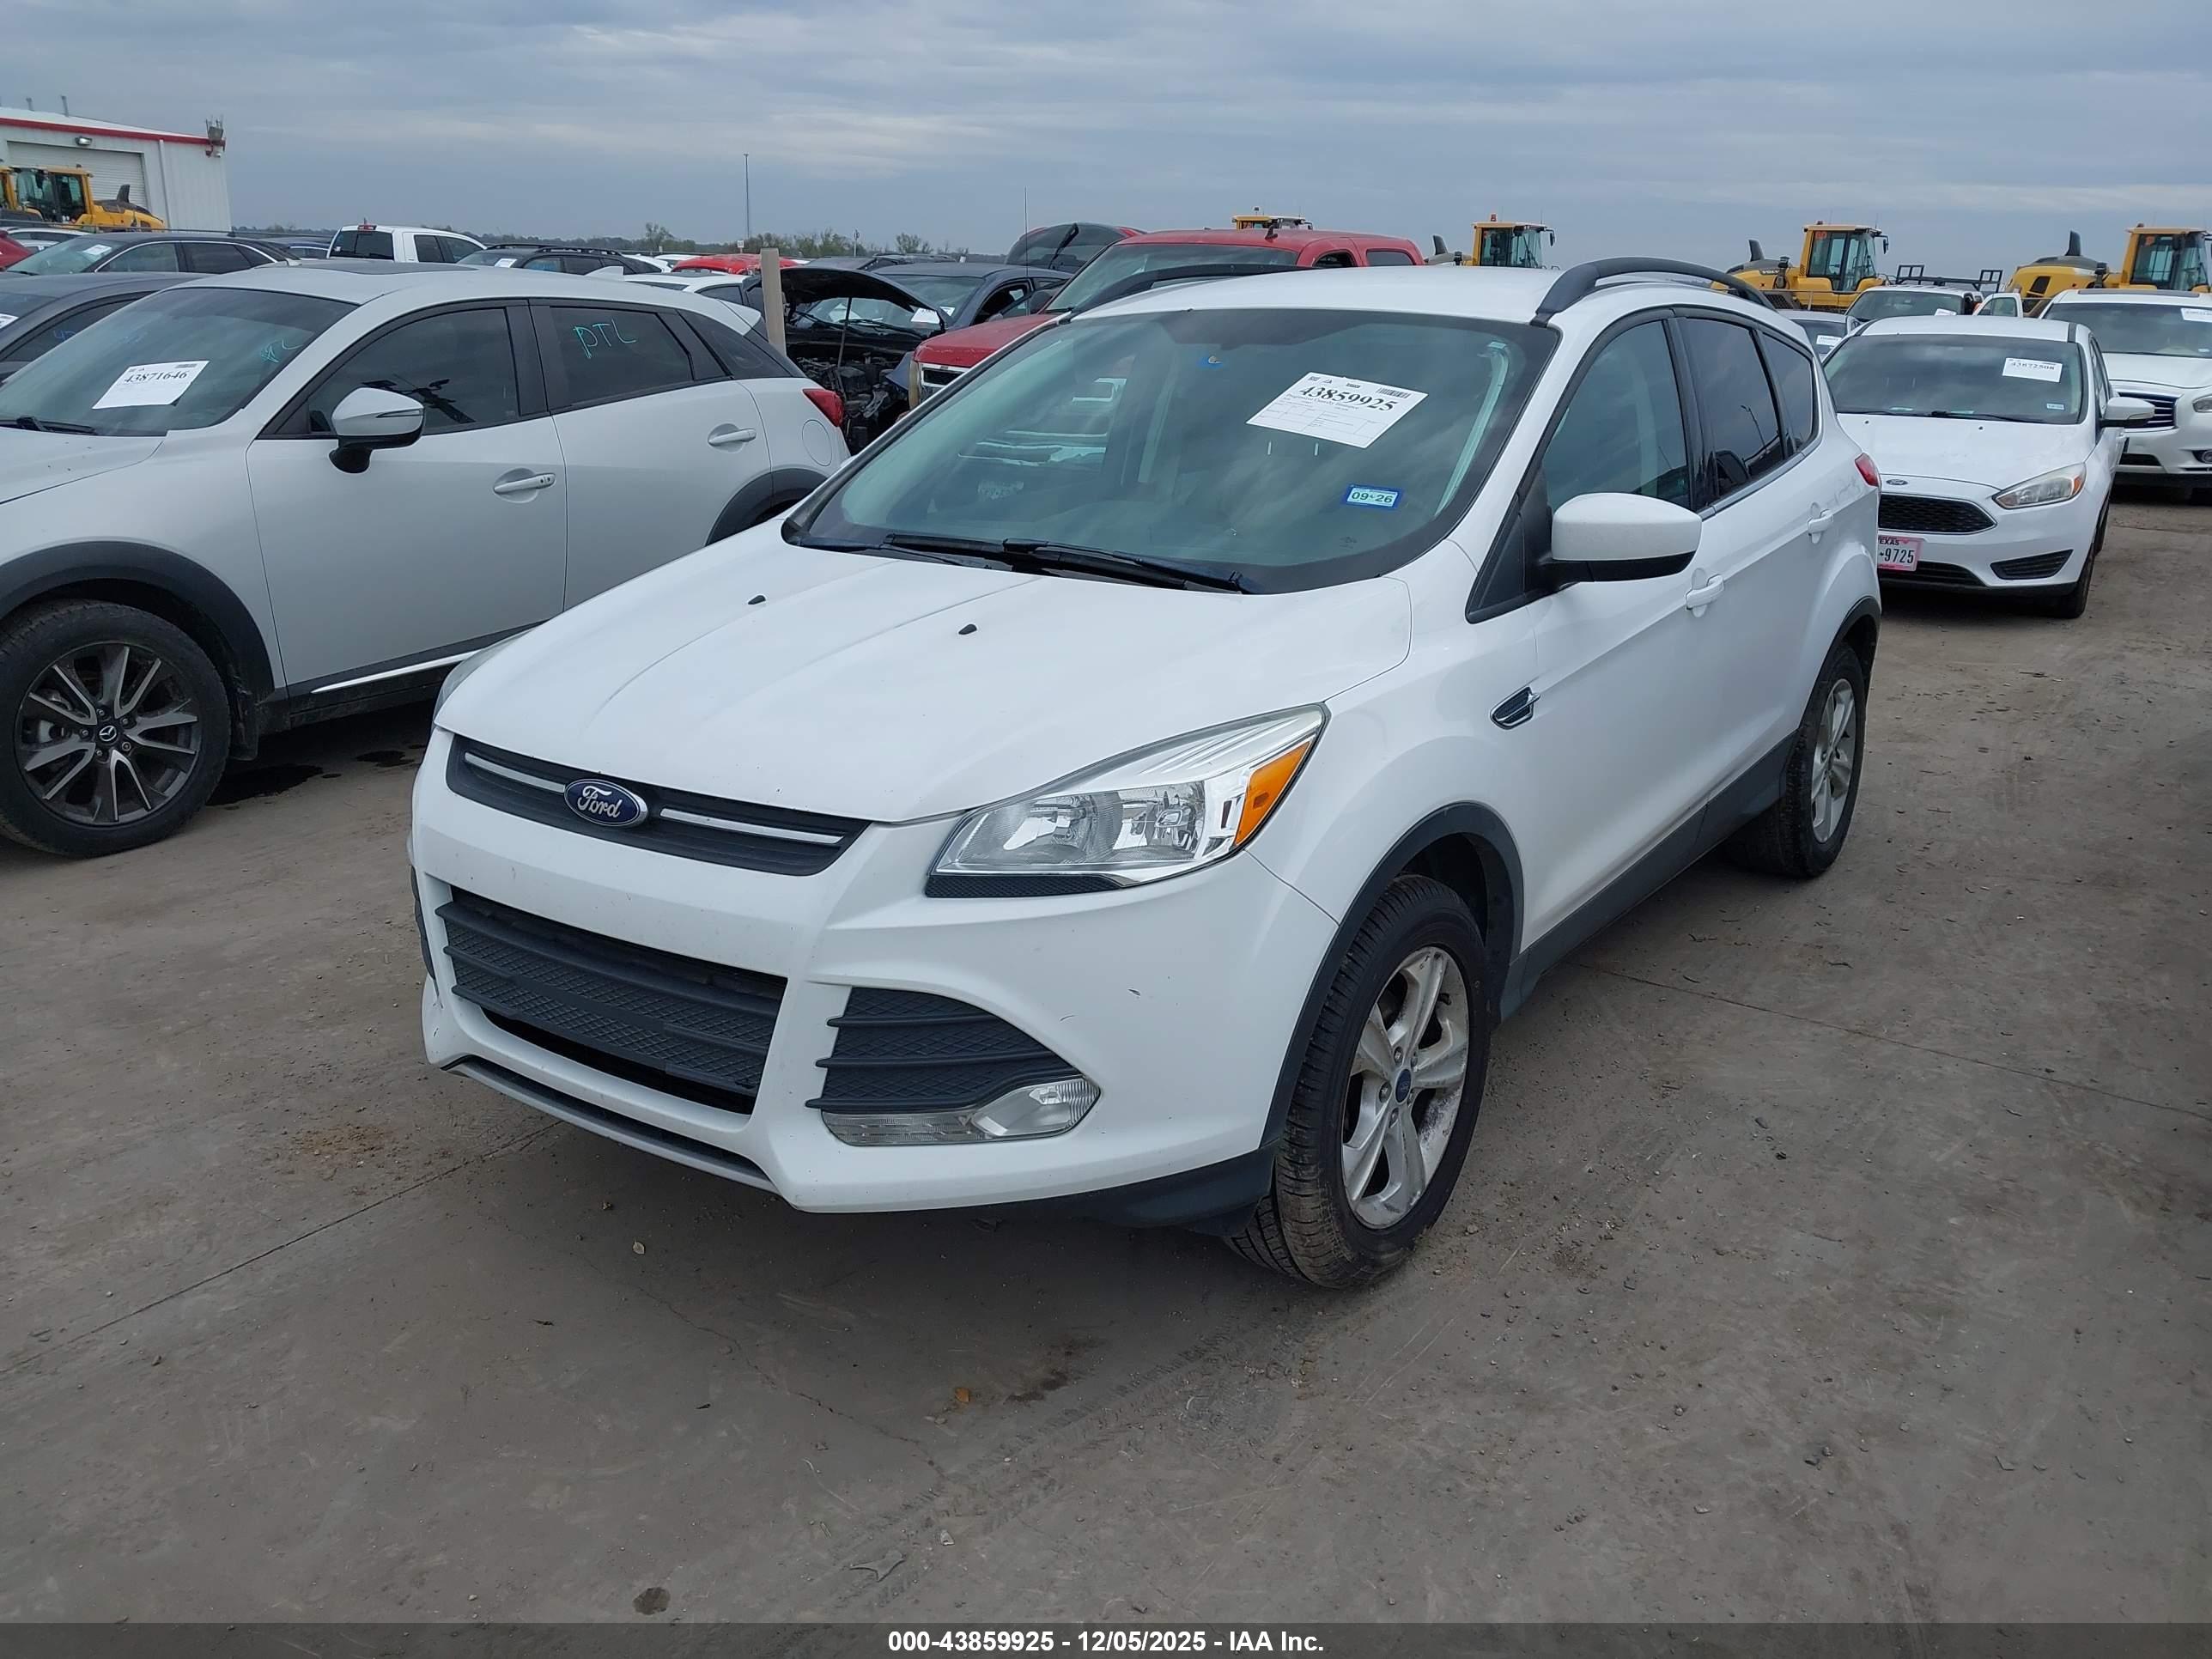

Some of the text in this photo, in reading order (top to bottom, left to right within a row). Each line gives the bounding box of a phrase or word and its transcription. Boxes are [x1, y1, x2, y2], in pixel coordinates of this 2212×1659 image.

[124, 369, 189, 384] 43871646
[1299, 386, 1399, 411] 43859925
[577, 785, 623, 818] Ford
